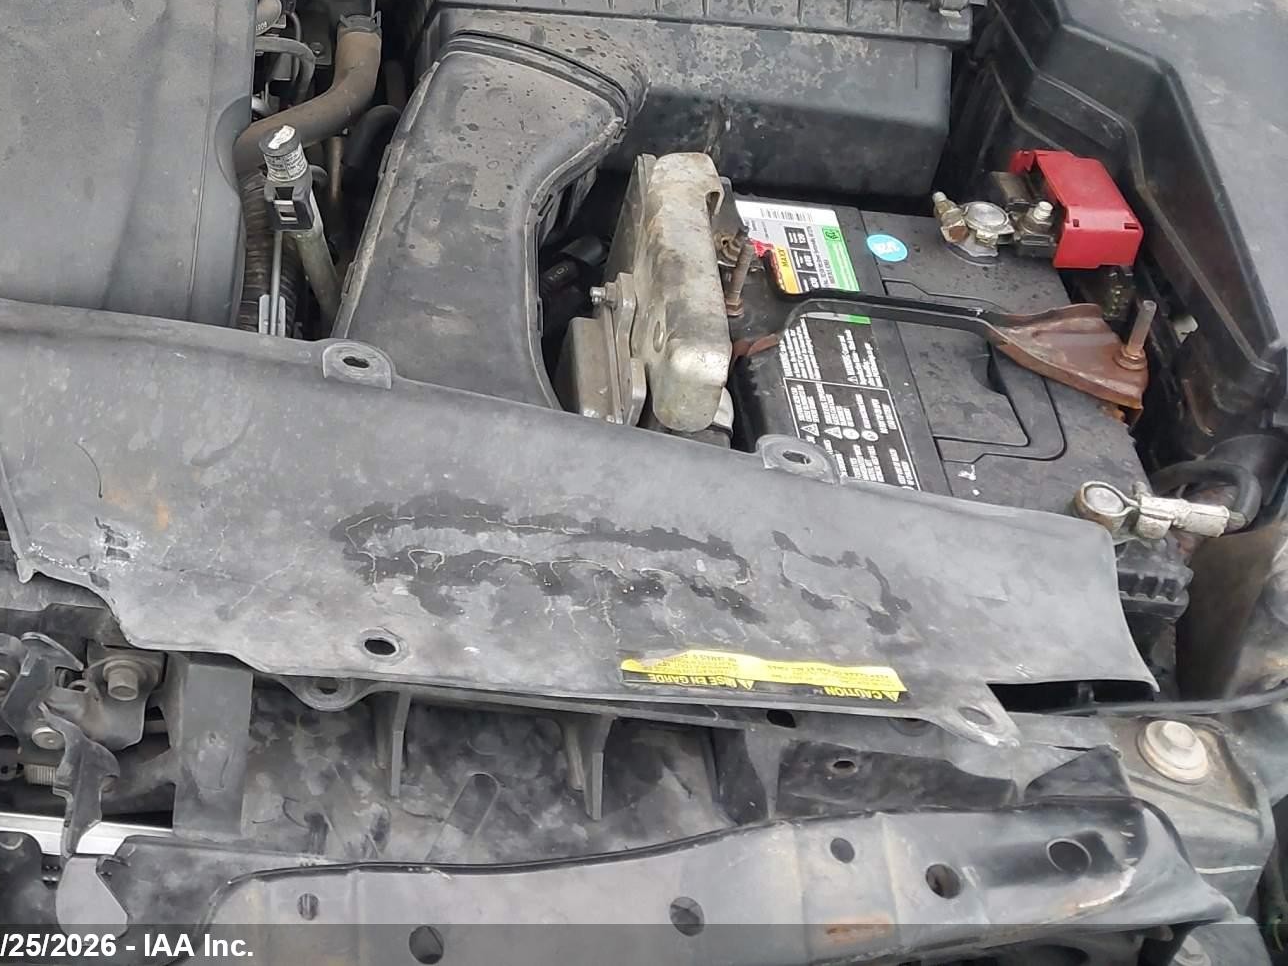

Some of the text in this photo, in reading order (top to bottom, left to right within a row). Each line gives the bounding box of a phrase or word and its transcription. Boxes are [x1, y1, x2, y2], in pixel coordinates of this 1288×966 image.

[647, 673, 690, 685] GARDE
[692, 676, 707, 686] EN
[823, 686, 883, 700] CAUTION
